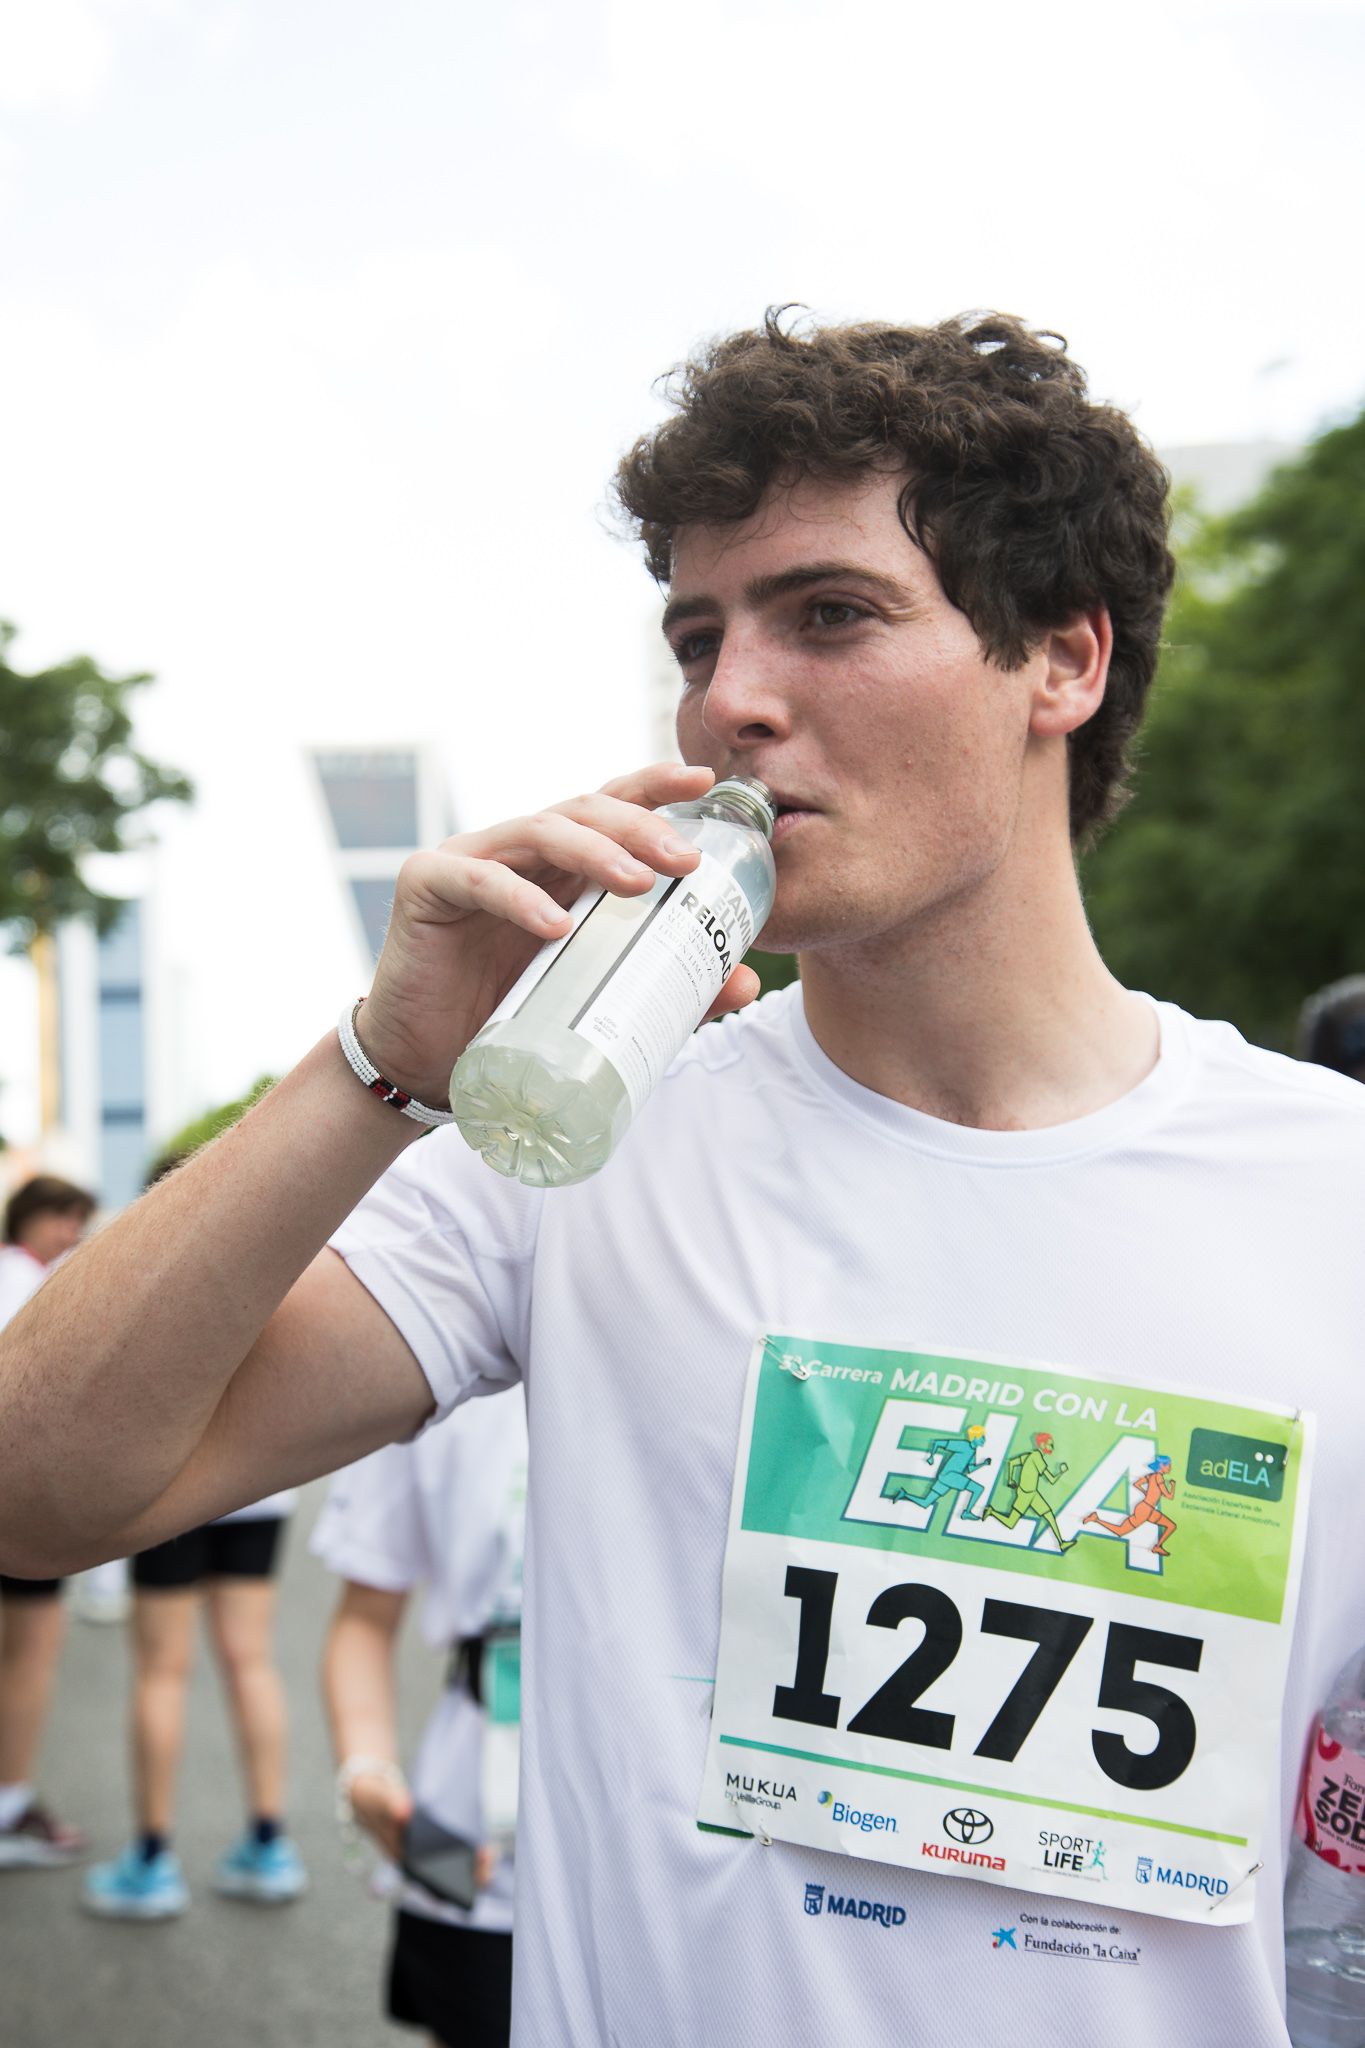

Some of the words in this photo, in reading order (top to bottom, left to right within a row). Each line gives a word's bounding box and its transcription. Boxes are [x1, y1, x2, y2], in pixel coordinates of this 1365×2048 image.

[680, 891, 732, 984] RELOAD
[806, 1358, 883, 1385] Carrera
[889, 1367, 1025, 1407] MADRID
[1033, 1388, 1108, 1422] CON
[1114, 1403, 1157, 1432] LA
[841, 1396, 1163, 1575] ELA
[1200, 1458, 1270, 1489] adELA
[772, 1565, 1204, 1791] 1275
[726, 1772, 797, 1802] MUKUA
[1319, 1776, 1365, 1822] ZE
[1038, 1831, 1094, 1853] SPORT
[1043, 1850, 1084, 1873] LIFE
[1156, 1866, 1229, 1897] MADRID
[827, 1895, 906, 1928] MADRID
[1019, 1912, 1039, 1925] Con
[1040, 1916, 1049, 1927] la
[1051, 1919, 1108, 1934] colaboración
[1024, 1934, 1090, 1957] Fundación
